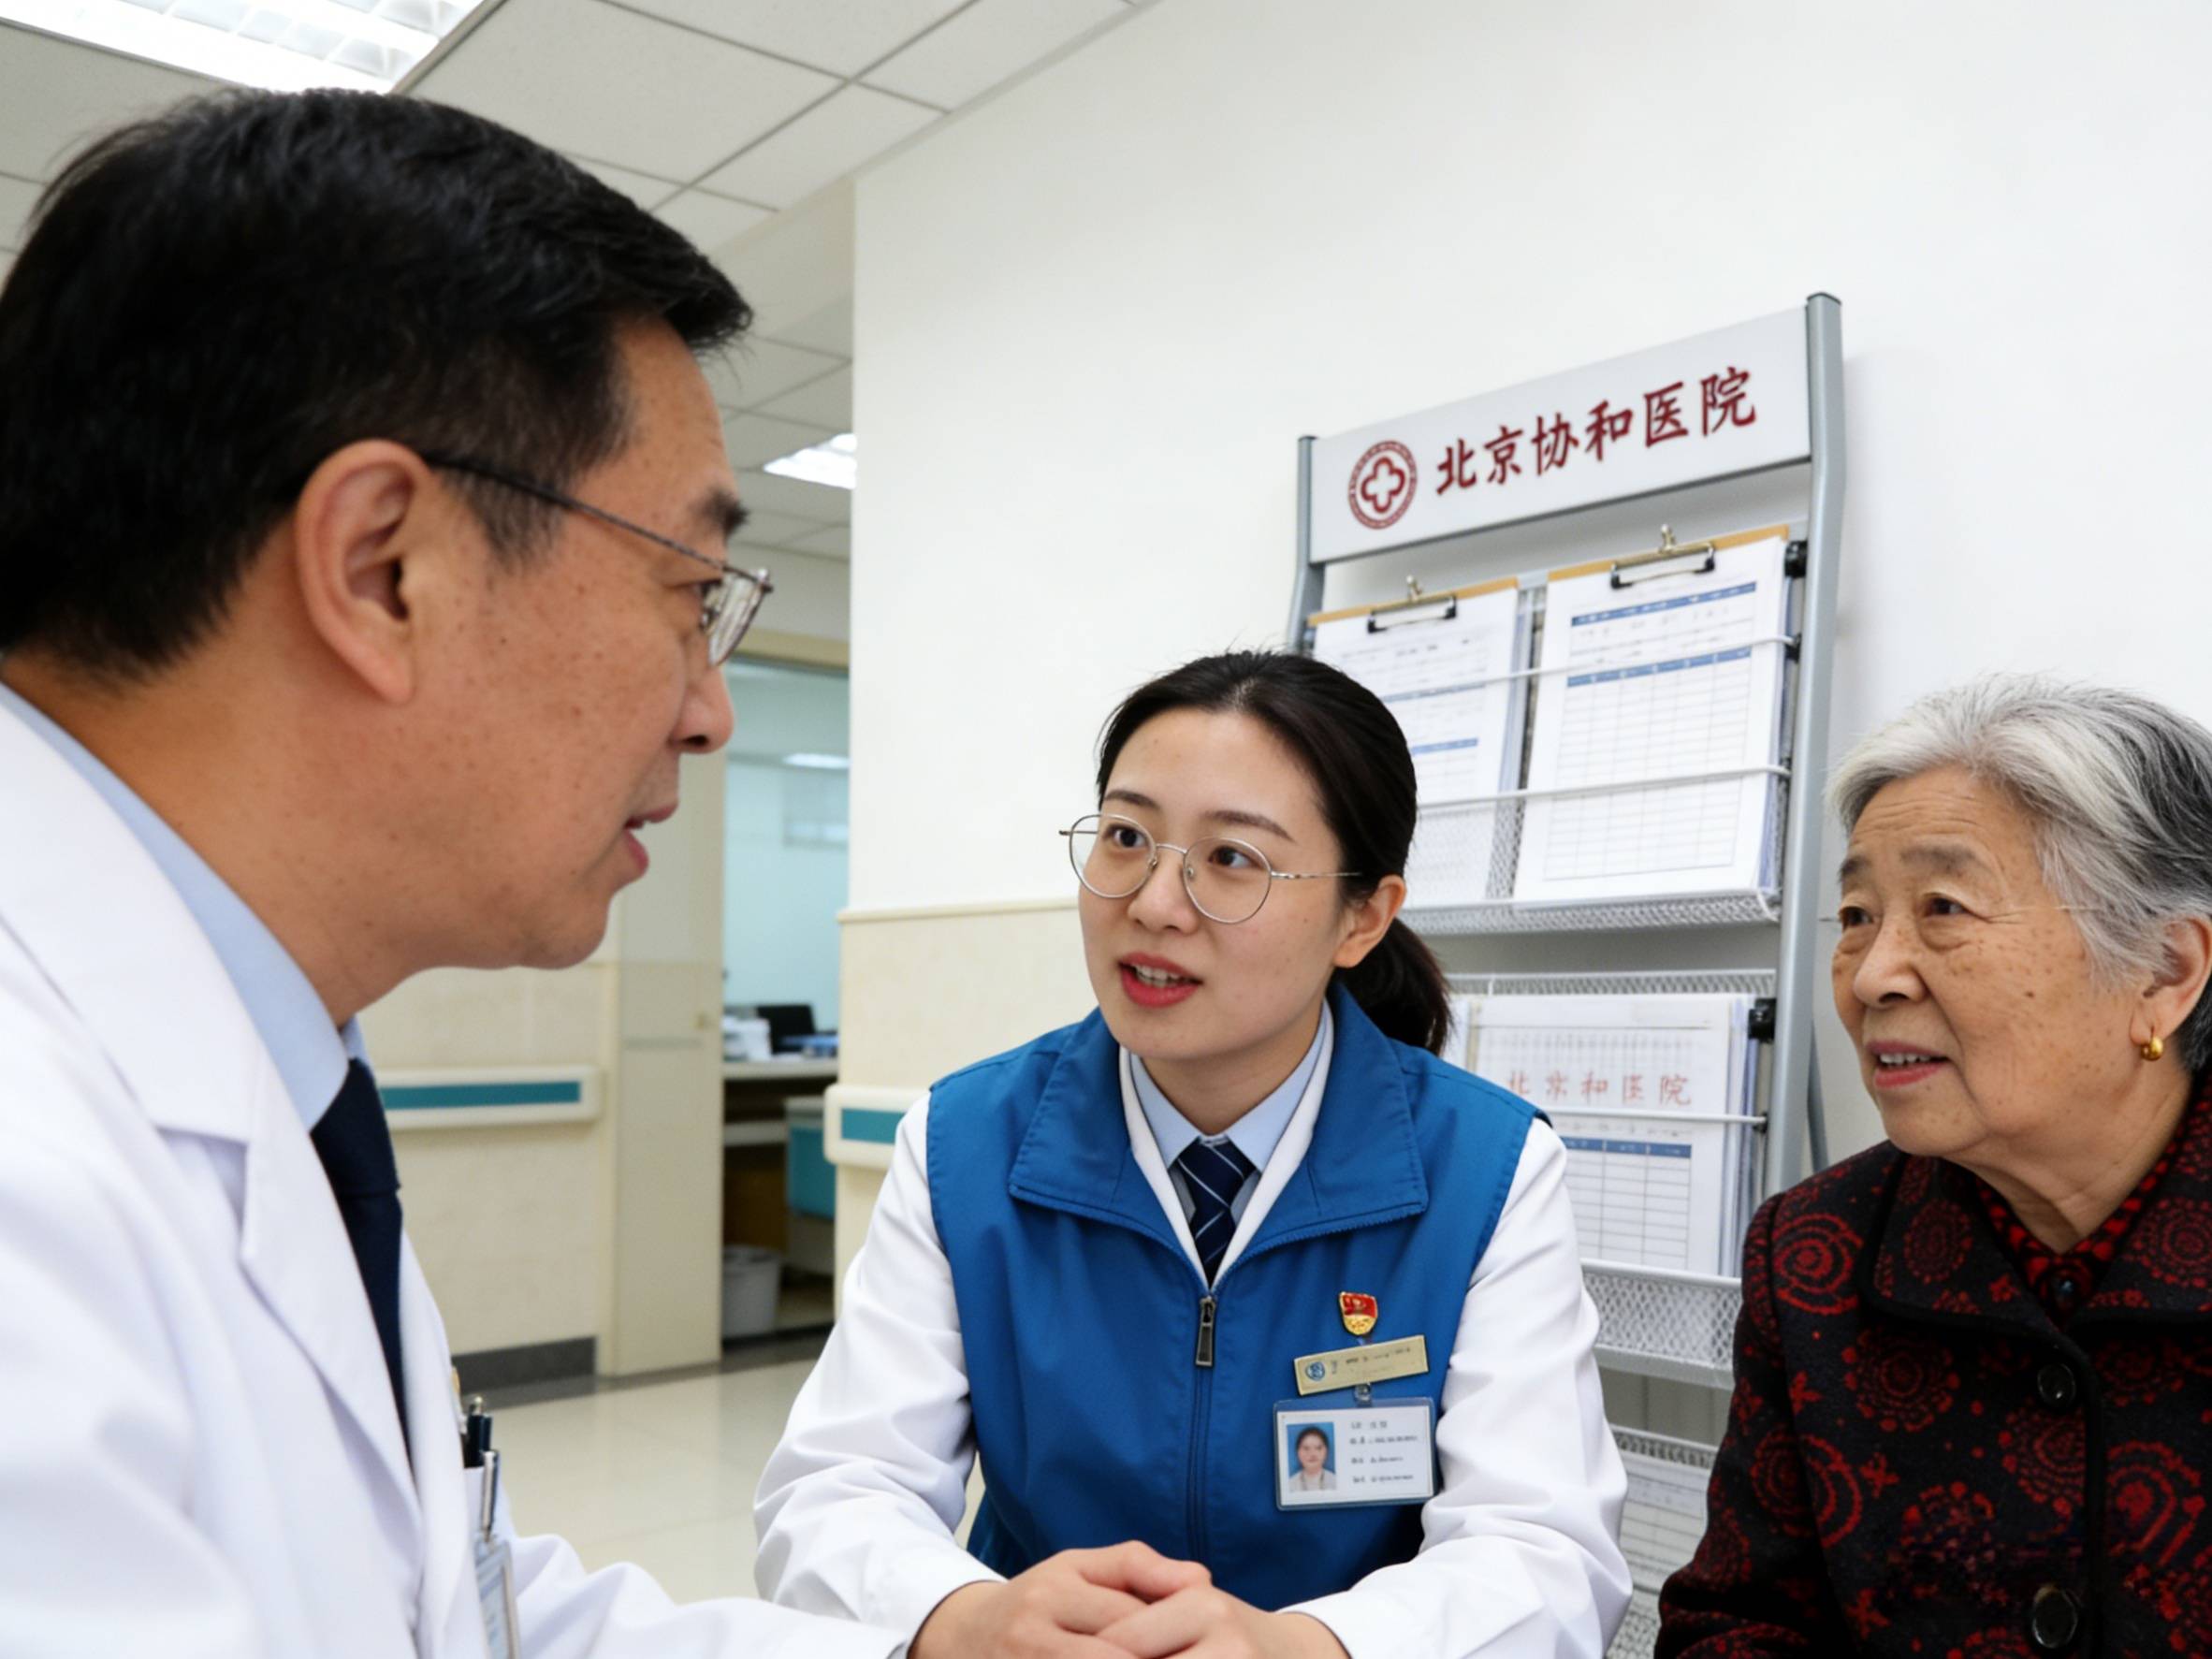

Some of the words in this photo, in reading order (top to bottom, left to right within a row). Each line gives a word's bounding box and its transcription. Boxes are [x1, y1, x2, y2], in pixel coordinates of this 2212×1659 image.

[1436, 366, 1757, 494] 北京协和医院
